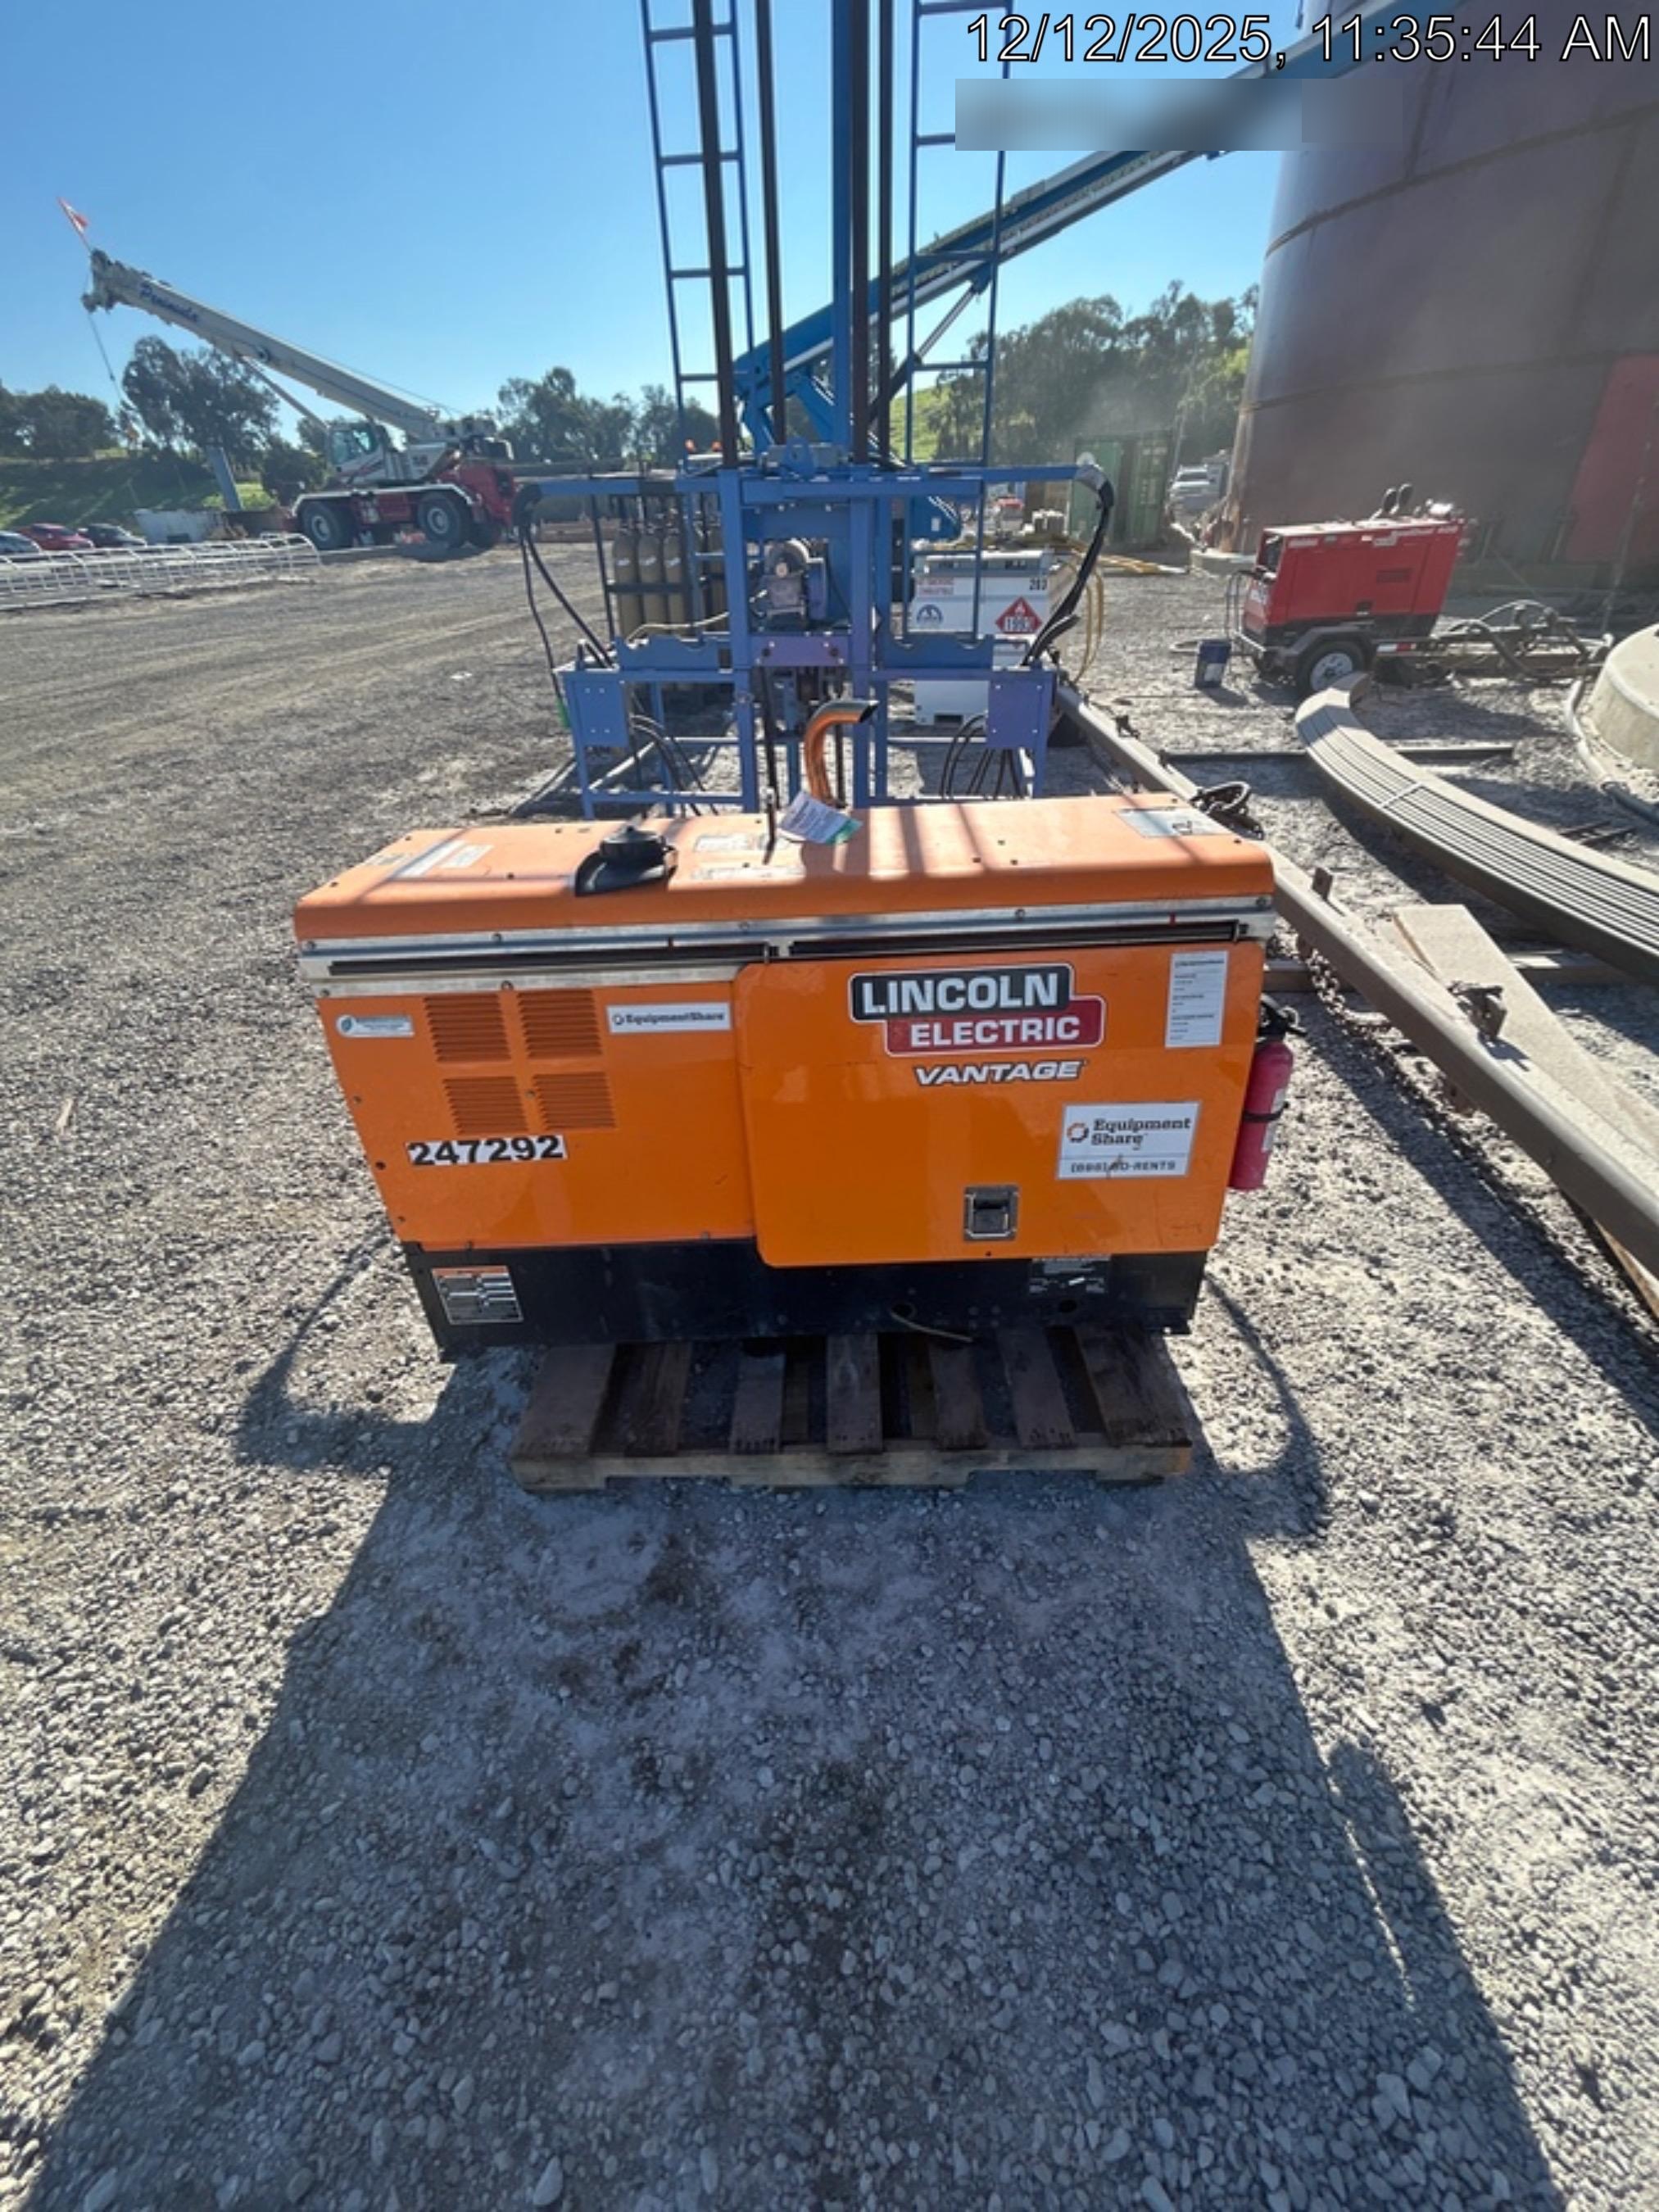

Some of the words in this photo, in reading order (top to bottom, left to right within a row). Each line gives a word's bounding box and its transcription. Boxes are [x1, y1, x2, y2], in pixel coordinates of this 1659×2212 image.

[863, 972, 1058, 1015] LINCOLN
[909, 1016, 1081, 1048] ELECTRIC
[913, 1059, 1082, 1086] VANTAGE
[1093, 1117, 1191, 1133] Equipment
[407, 1134, 564, 1166] 247292
[1090, 1132, 1144, 1150] Share
